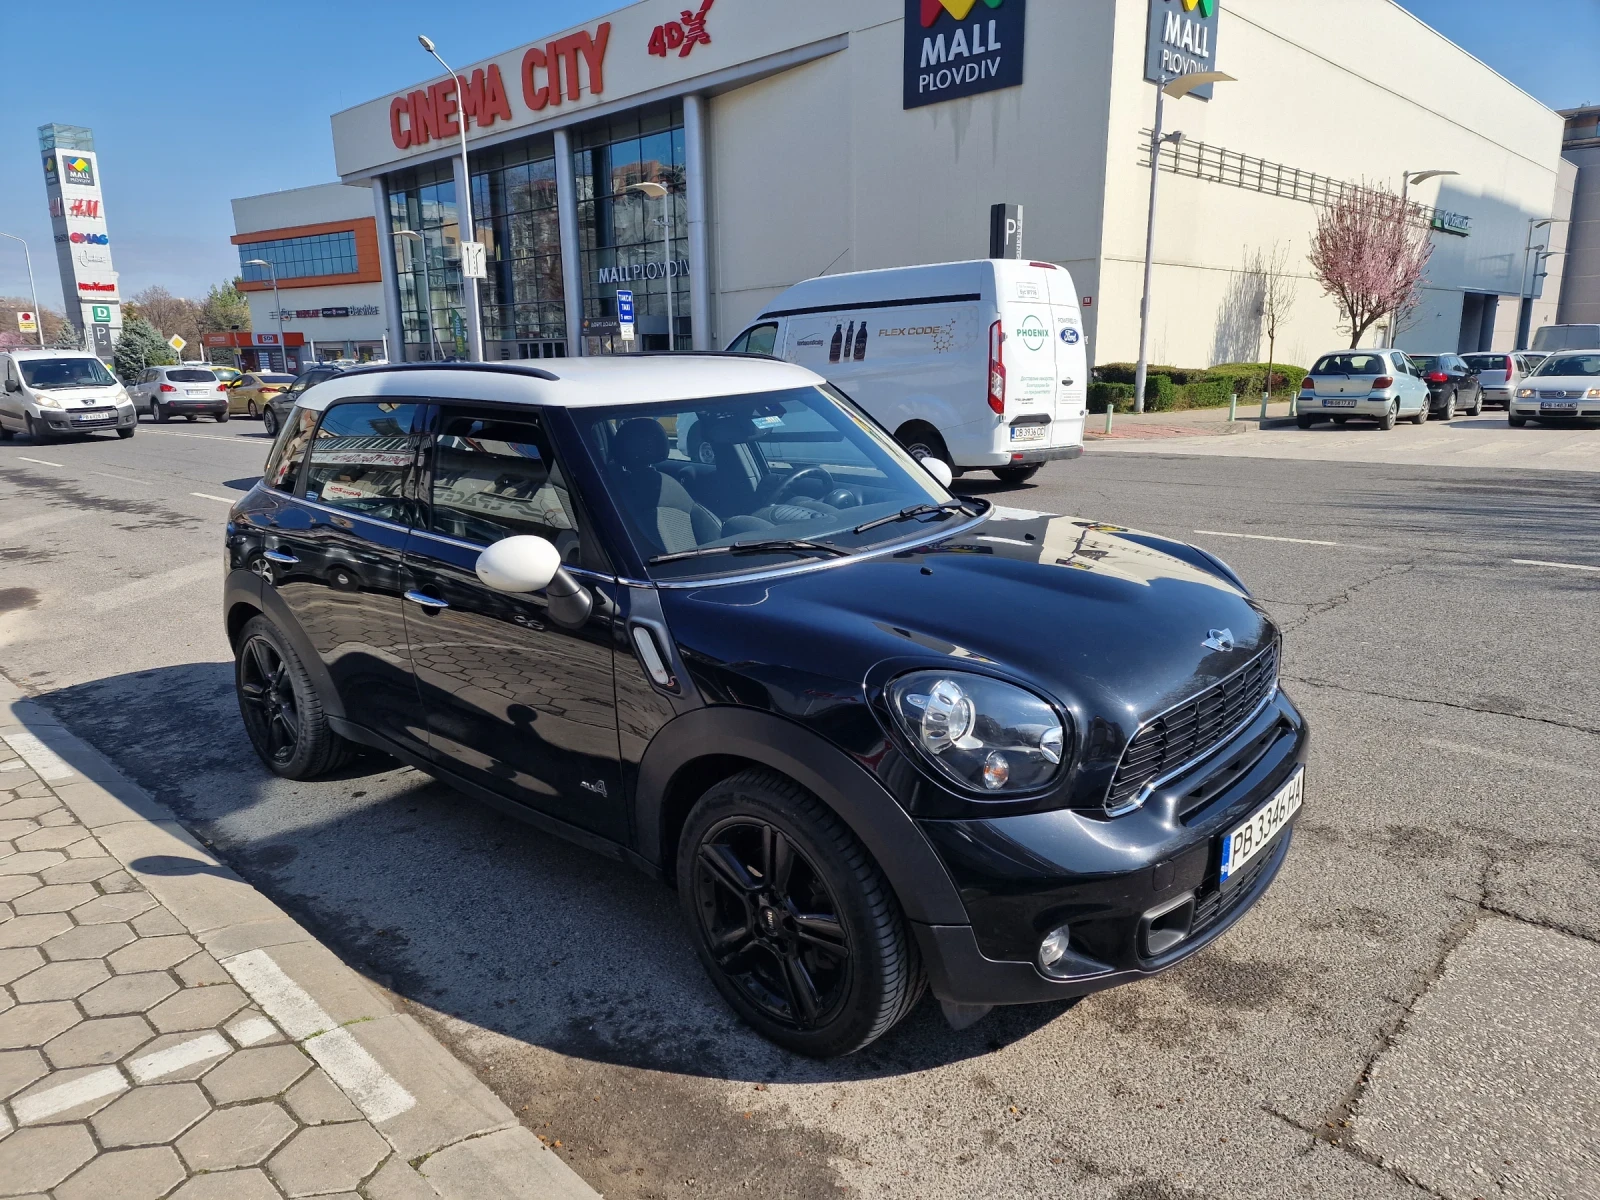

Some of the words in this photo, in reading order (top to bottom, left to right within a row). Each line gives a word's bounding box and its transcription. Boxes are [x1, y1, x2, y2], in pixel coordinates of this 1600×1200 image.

[647, 0, 715, 57] 4DX
[920, 19, 1001, 68] MALL
[1164, 10, 1209, 58] MALL
[389, 63, 513, 149] CINEMA
[521, 21, 611, 111] CITY
[919, 56, 1001, 94] PLOVDIV
[70, 171, 90, 179] MALL
[1006, 218, 1016, 245] P
[599, 265, 631, 284] MALL
[96, 327, 106, 339] P
[878, 328, 906, 337] FLEX
[907, 326, 941, 335] CODE
[1016, 328, 1049, 337] PHOENIX
[1231, 823, 1253, 868] PB
[1255, 791, 1286, 847] 3346
[1286, 776, 1301, 816] HA
